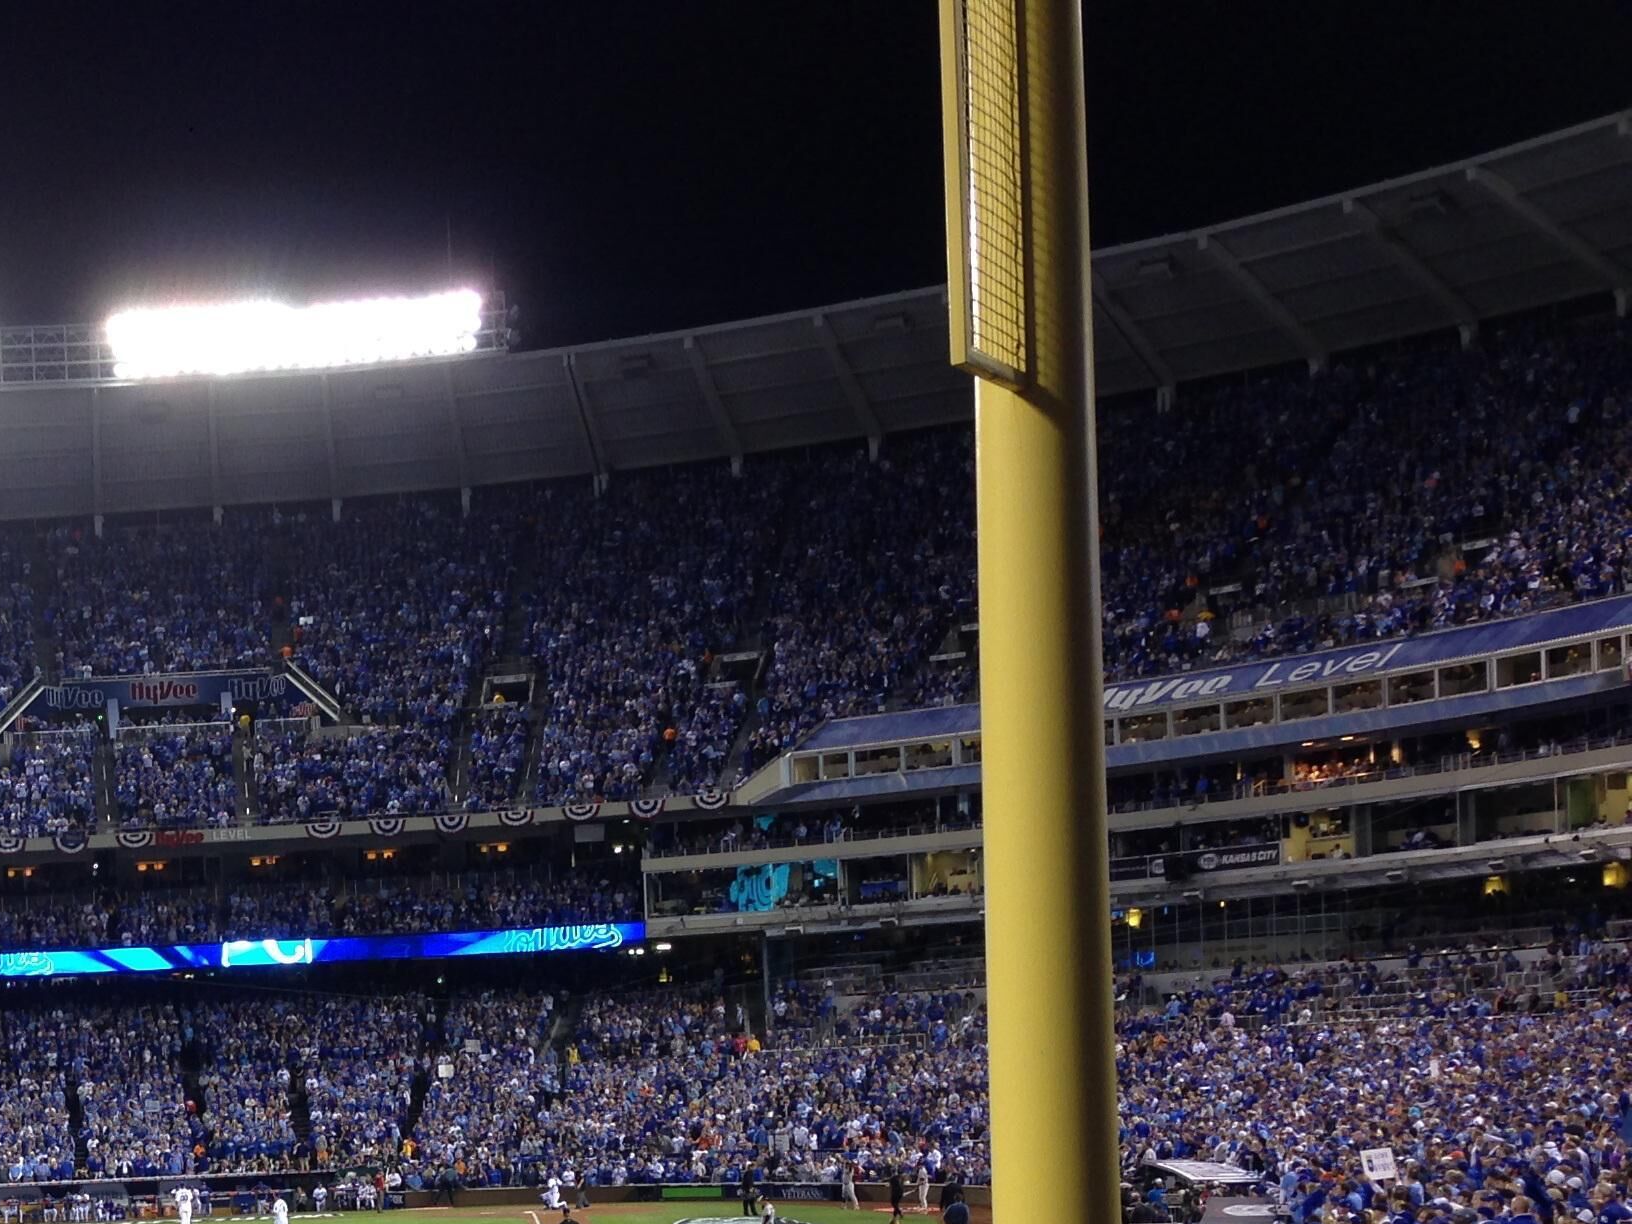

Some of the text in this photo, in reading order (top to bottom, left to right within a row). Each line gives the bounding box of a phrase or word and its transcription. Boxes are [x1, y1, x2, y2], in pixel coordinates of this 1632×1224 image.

[1255, 643, 1403, 688] Level
[131, 680, 198, 705] HyVee
[212, 829, 252, 841] LEVEL
